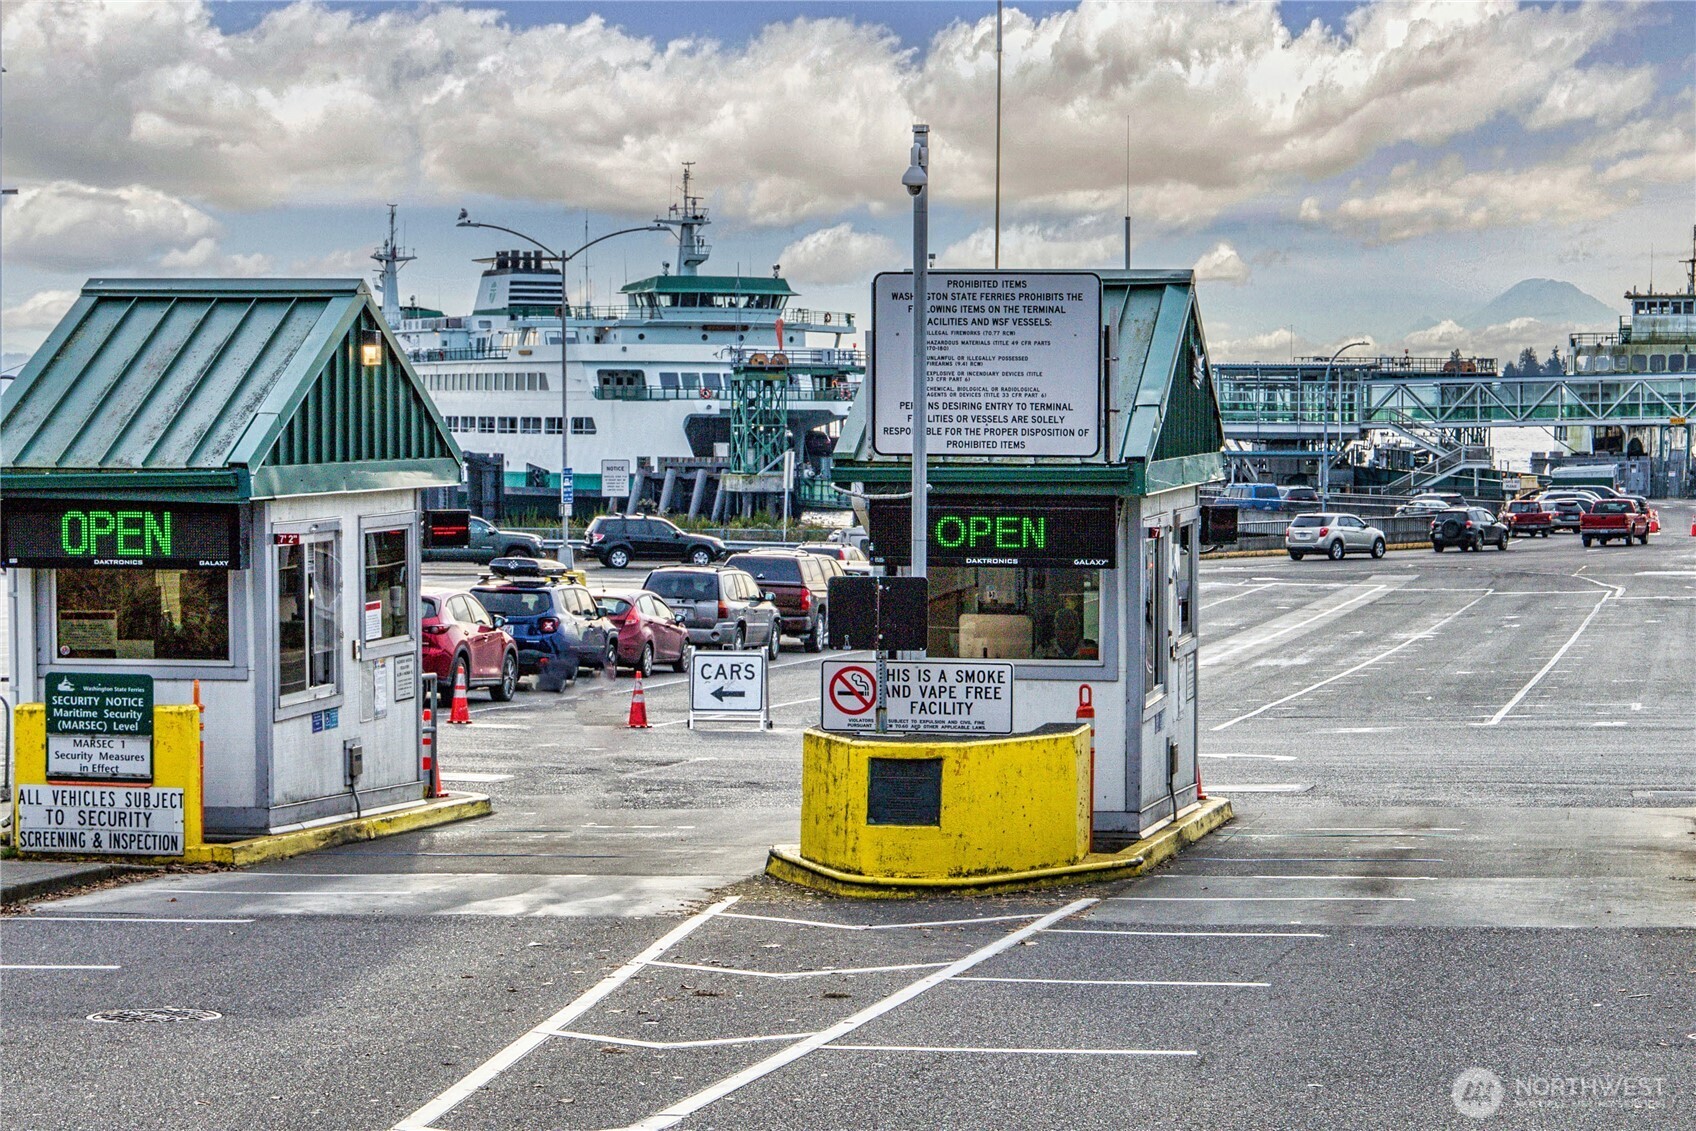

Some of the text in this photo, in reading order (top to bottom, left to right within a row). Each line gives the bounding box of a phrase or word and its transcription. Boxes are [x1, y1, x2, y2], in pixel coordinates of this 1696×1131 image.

[947, 280, 1027, 289] PROHIBITED ITEMS
[892, 292, 948, 300] WASHGTON
[951, 292, 976, 300] STATE
[980, 292, 1016, 301] FERRIES
[1018, 293, 1064, 301] PROHIBITS
[908, 305, 1066, 314] FOWING ITEMS ON THE TERMINAL
[927, 318, 1052, 326] ACILITIES AND WSF VESSELS:
[827, 351, 830, 361] 1
[1030, 403, 1073, 411] TERMINAL
[970, 415, 1008, 423] VESSELS
[883, 427, 942, 435] RESPOBLE
[946, 440, 998, 448] PROHIBITED
[62, 511, 171, 555] OPEN
[935, 516, 1044, 548] OPEN
[701, 663, 755, 680] CARS
[887, 669, 1005, 684] HIS IS A SMOKE
[919, 685, 957, 699] VAPE
[966, 686, 1002, 700] FREE
[52, 696, 144, 707] SECURITY NOTICE
[910, 701, 973, 715] FACILITY
[53, 708, 142, 721] Maritime Security
[58, 721, 138, 732] (MARSEC) Level
[73, 739, 125, 748] MARSEC 1
[55, 751, 145, 762] Security Measures
[80, 764, 119, 773] in Effect
[19, 789, 183, 809] ALL VEHICLES SUBJECT
[46, 809, 152, 828] TO SECURITY
[20, 831, 178, 851] SCREENING & INSPECTION
